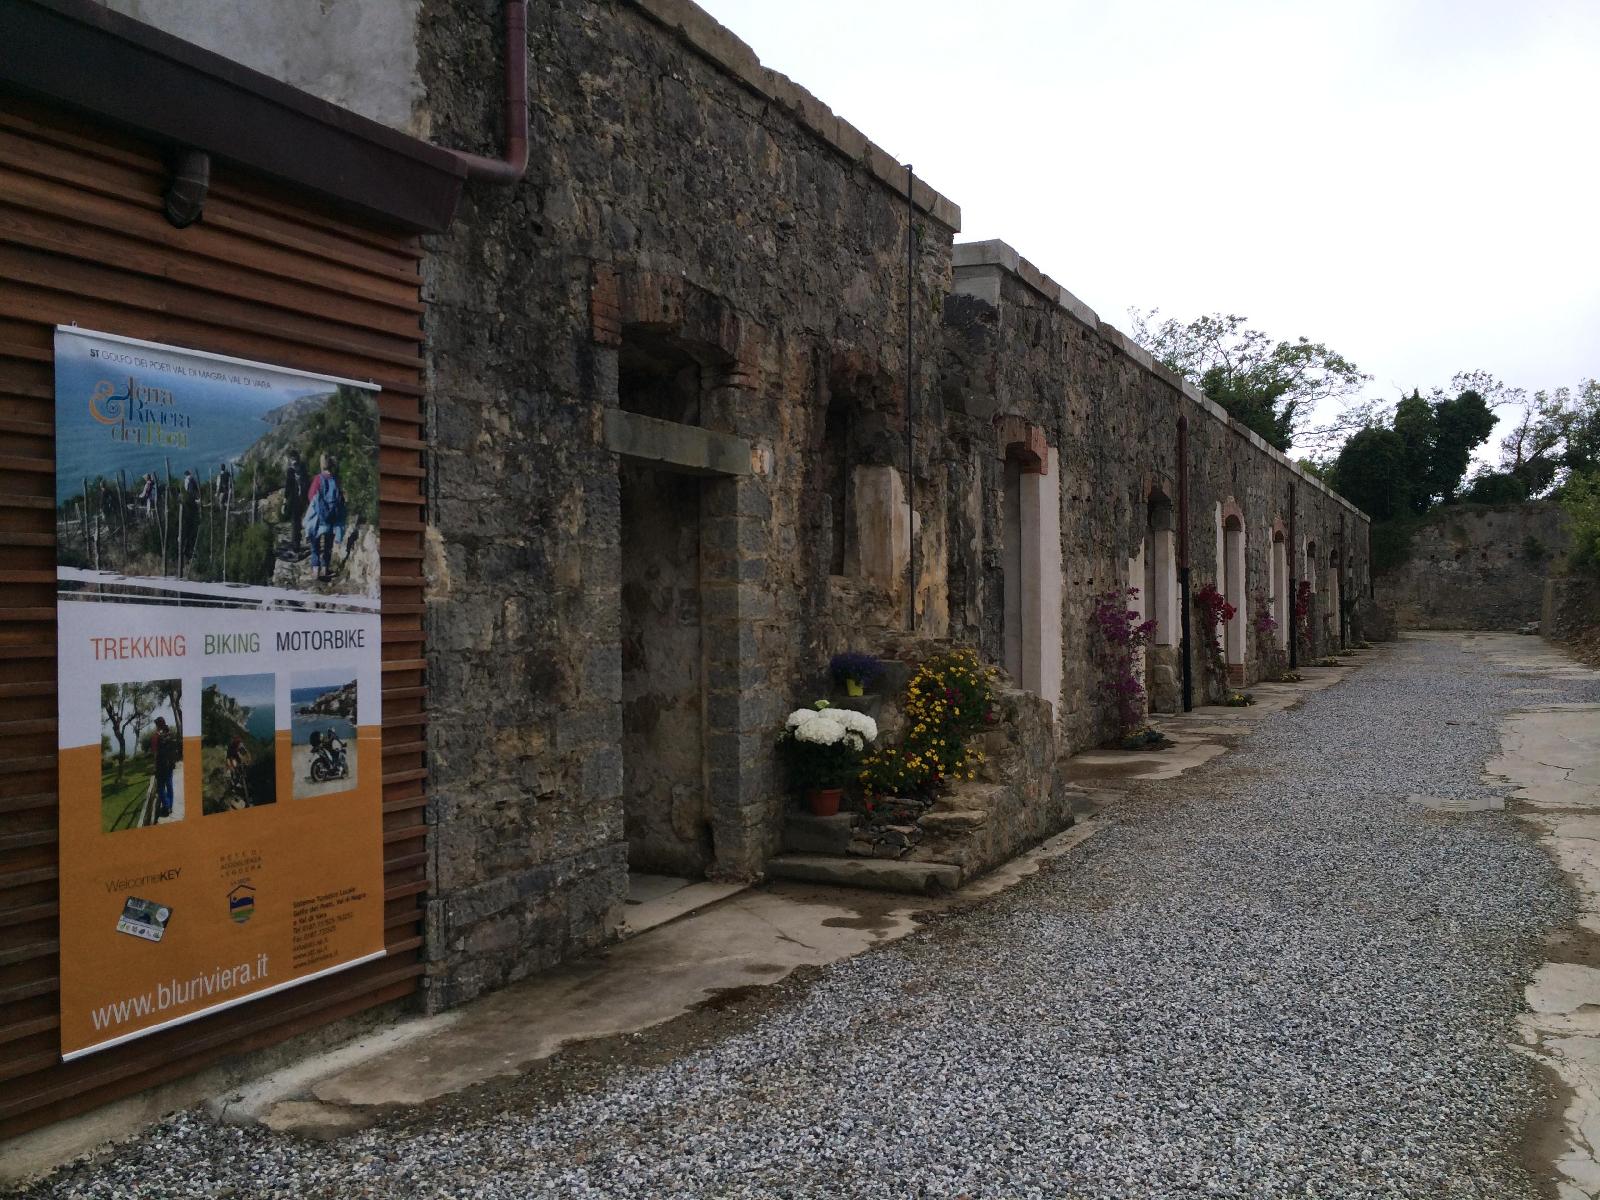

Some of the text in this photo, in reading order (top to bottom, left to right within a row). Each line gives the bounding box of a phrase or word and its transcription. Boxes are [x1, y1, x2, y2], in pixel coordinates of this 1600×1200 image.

[90, 348, 99, 358] ST
[101, 350, 133, 365] GOLFO
[134, 357, 148, 368] DEI
[173, 367, 187, 376] VAL
[189, 368, 197, 377] DI
[90, 629, 365, 660] TREKKING BIKING MOTORBIKE
[91, 953, 269, 1030] www.bluriviera.it
